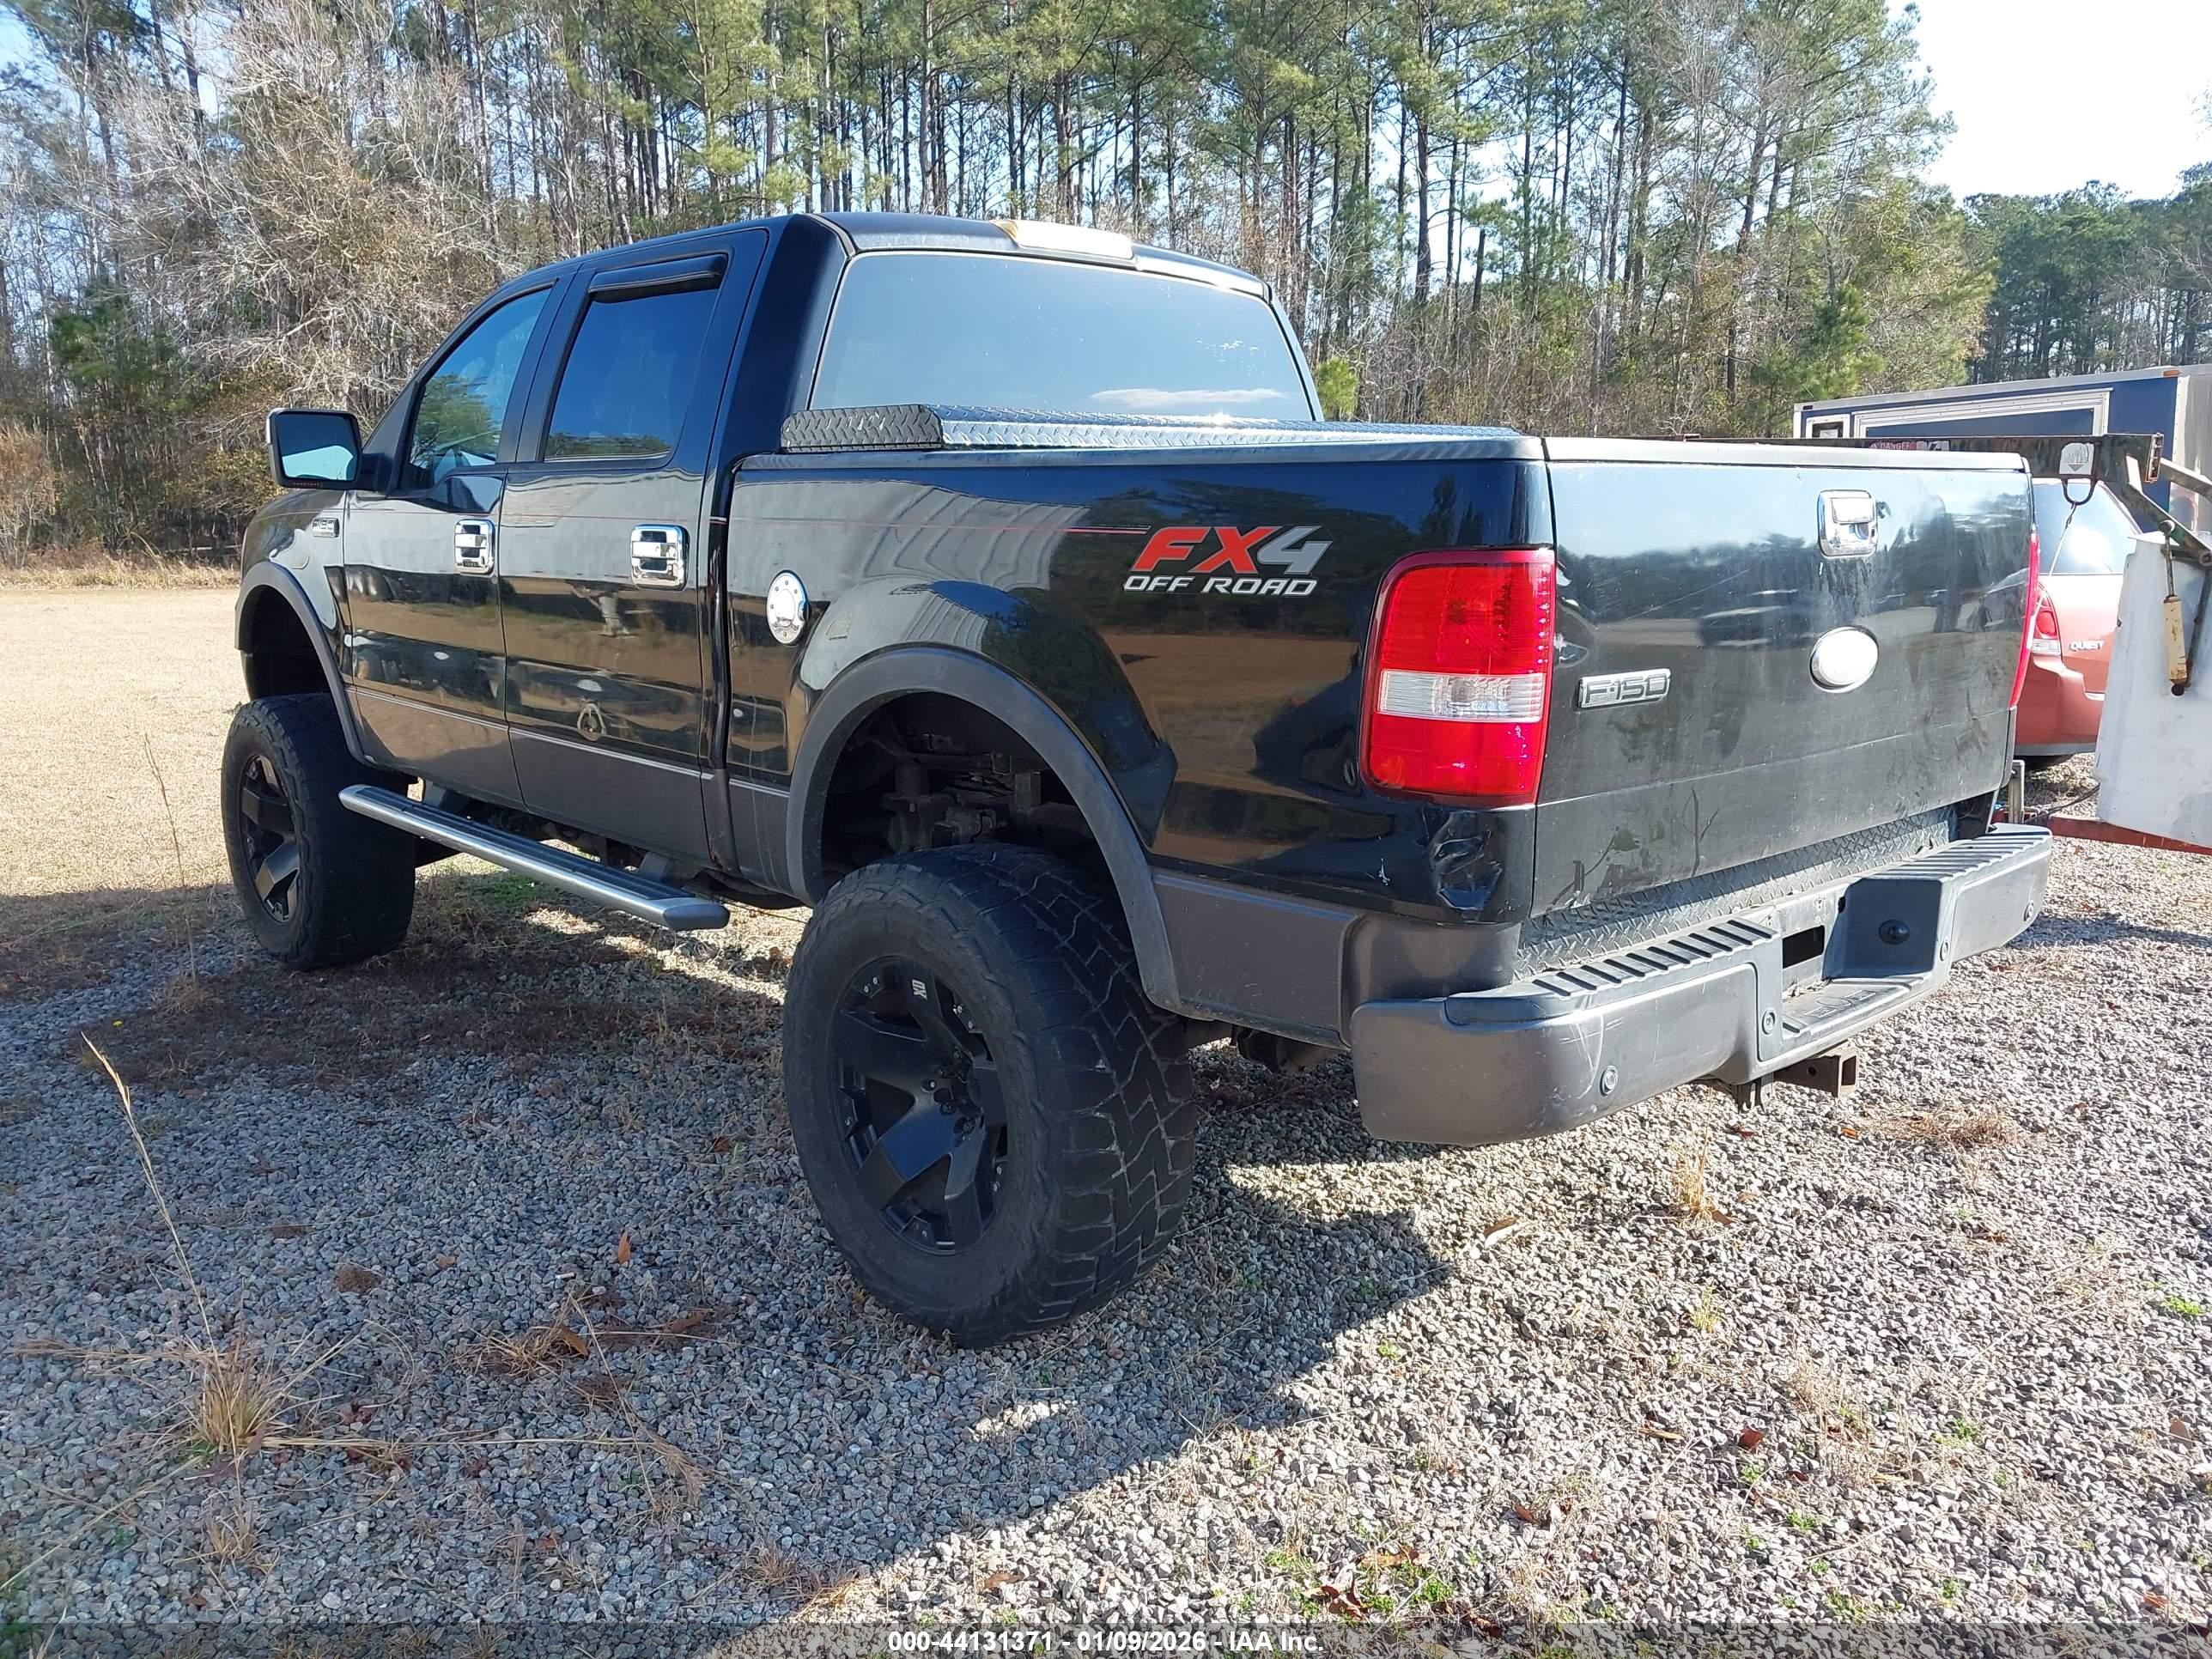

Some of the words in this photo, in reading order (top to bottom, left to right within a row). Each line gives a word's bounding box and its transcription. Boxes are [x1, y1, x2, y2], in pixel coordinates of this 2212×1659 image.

[1130, 526, 1333, 574] FX4
[1124, 575, 1195, 592] OFF
[1200, 578, 1317, 596] ROAD
[2069, 641, 2103, 651] QUEST
